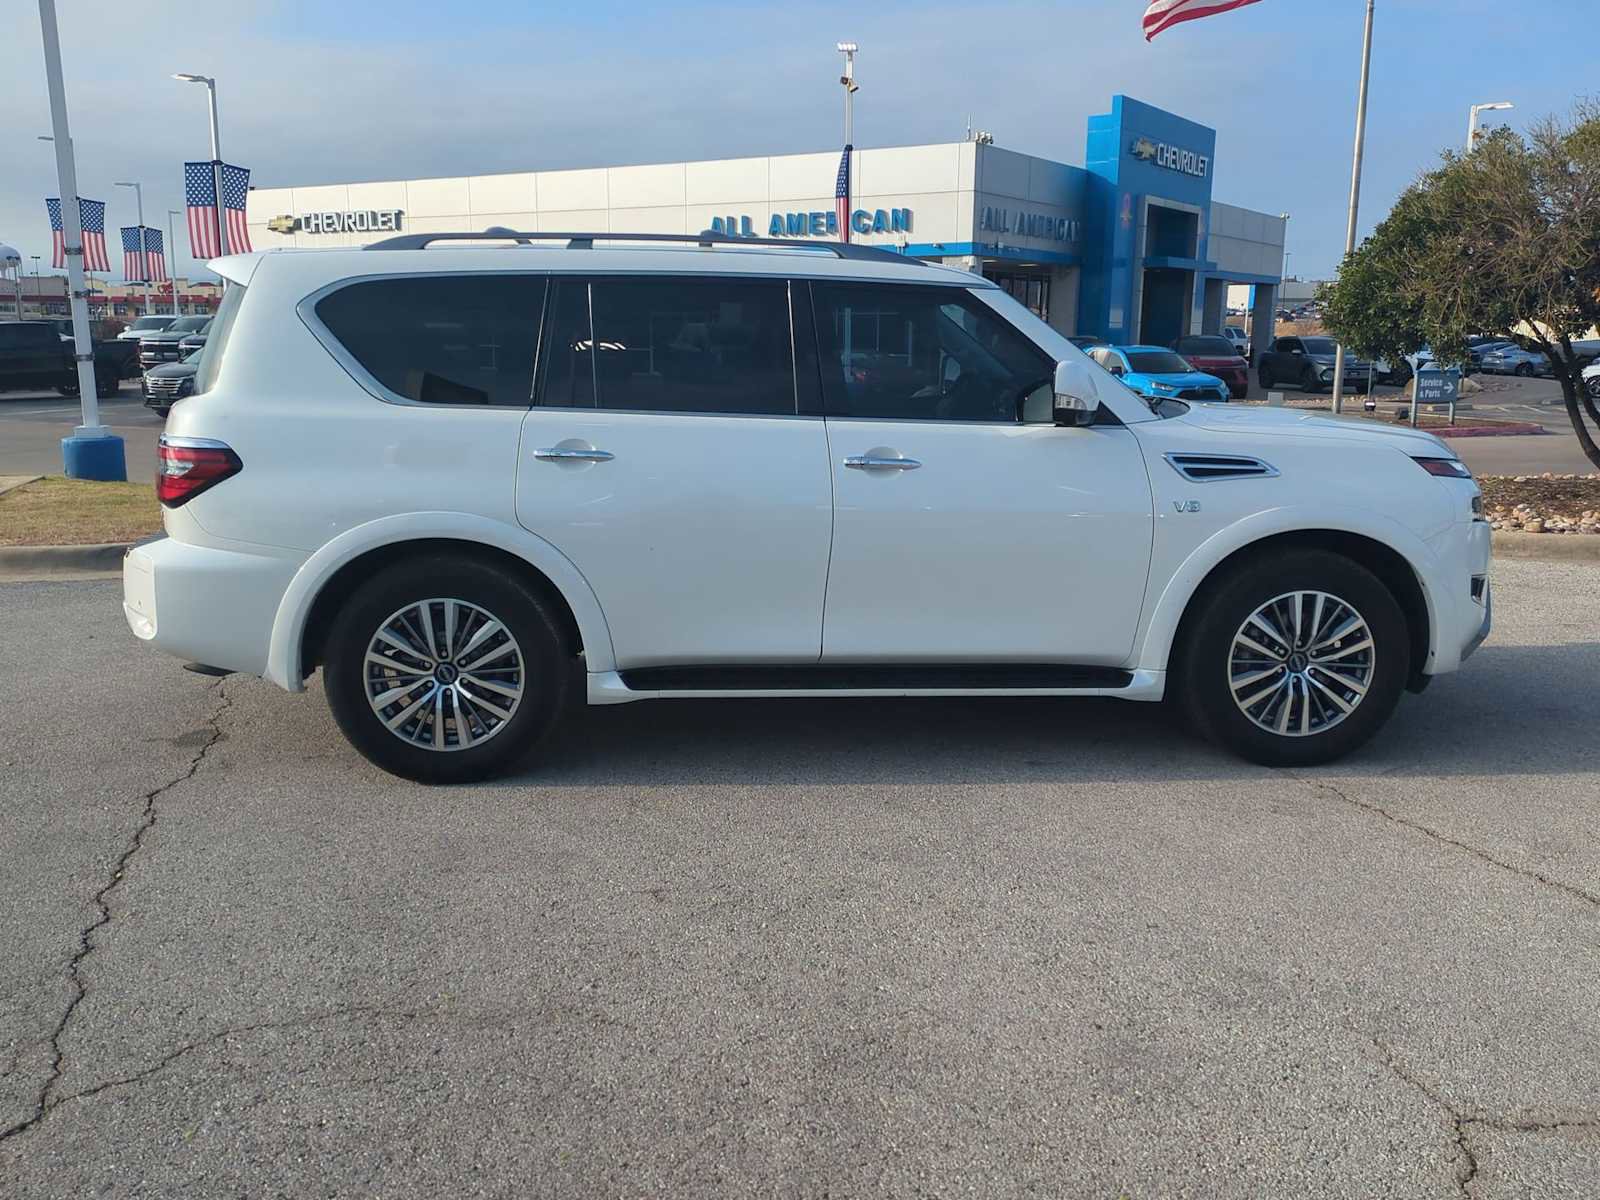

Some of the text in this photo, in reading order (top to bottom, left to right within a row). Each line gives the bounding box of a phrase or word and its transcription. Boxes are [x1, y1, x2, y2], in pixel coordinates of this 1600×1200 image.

[1157, 143, 1209, 177] CHEVROLET
[301, 210, 402, 233] CHEVROLET
[711, 208, 912, 237] ALL AMERCAN
[1420, 378, 1443, 387] Service
